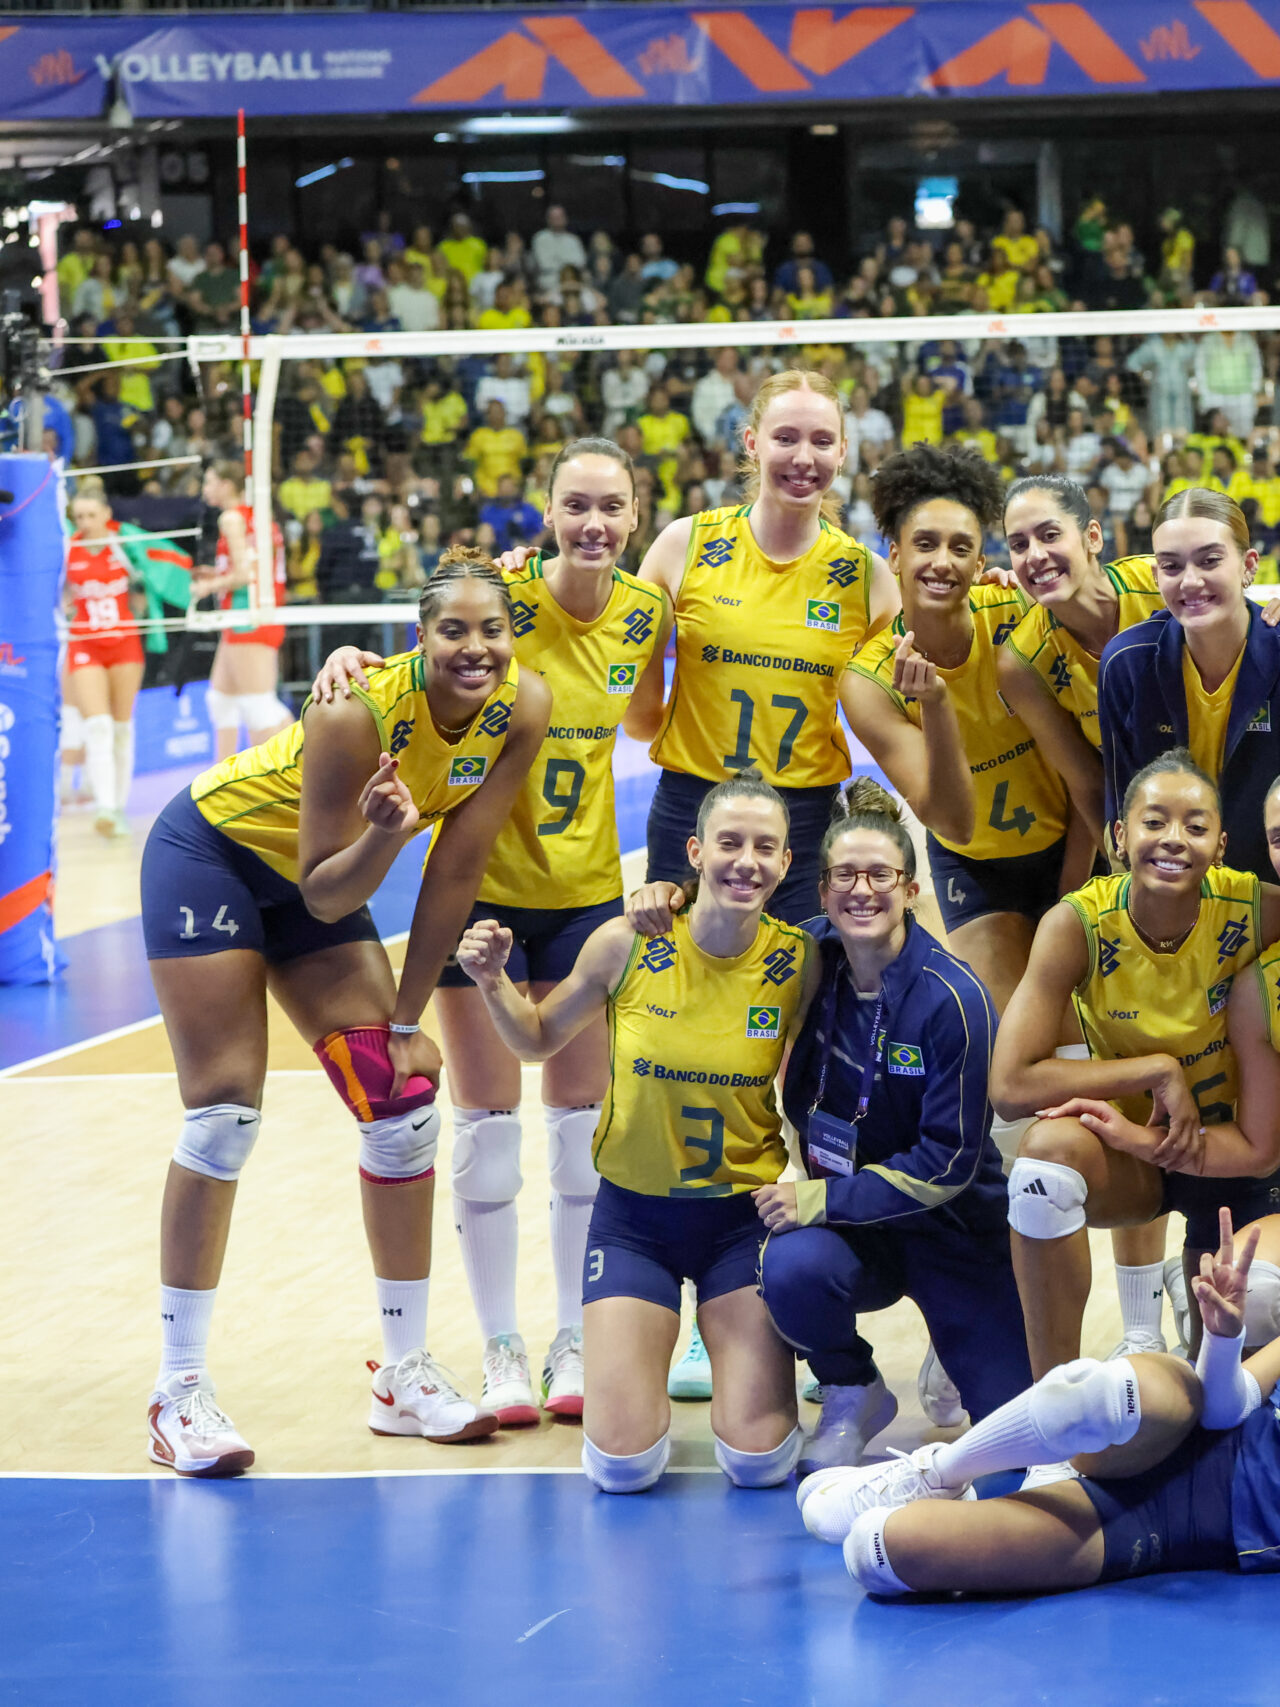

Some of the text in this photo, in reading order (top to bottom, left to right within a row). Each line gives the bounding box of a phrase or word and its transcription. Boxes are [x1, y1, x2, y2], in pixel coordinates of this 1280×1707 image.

[95, 50, 321, 82] VOLLEYBALL
[713, 594, 742, 607] VOLT
[807, 620, 839, 632] BRASIL
[722, 649, 835, 677] BANCO DO BRASIL
[608, 685, 633, 694] BRASIL
[546, 726, 574, 740] NCO
[576, 727, 593, 740] DO
[723, 689, 808, 773] 17
[1250, 722, 1270, 731] ASIL
[970, 759, 997, 774] NCO
[997, 750, 1016, 765] DO
[450, 776, 482, 785] BRASIL
[538, 758, 586, 836] 9
[989, 780, 1036, 837] 4
[947, 877, 967, 905] 4
[179, 905, 240, 939] 14
[646, 1004, 677, 1020] VOLT
[1107, 1009, 1139, 1020] VOLT
[1210, 1000, 1227, 1016] BRA
[747, 1029, 778, 1039] BRASIL
[870, 1003, 883, 1046] VOLLEYBALL
[654, 1065, 707, 1084] BANCO
[709, 1071, 730, 1086] DO
[889, 1065, 924, 1075] BRASIL
[680, 1105, 725, 1183] 3
[588, 1249, 604, 1282] 3
